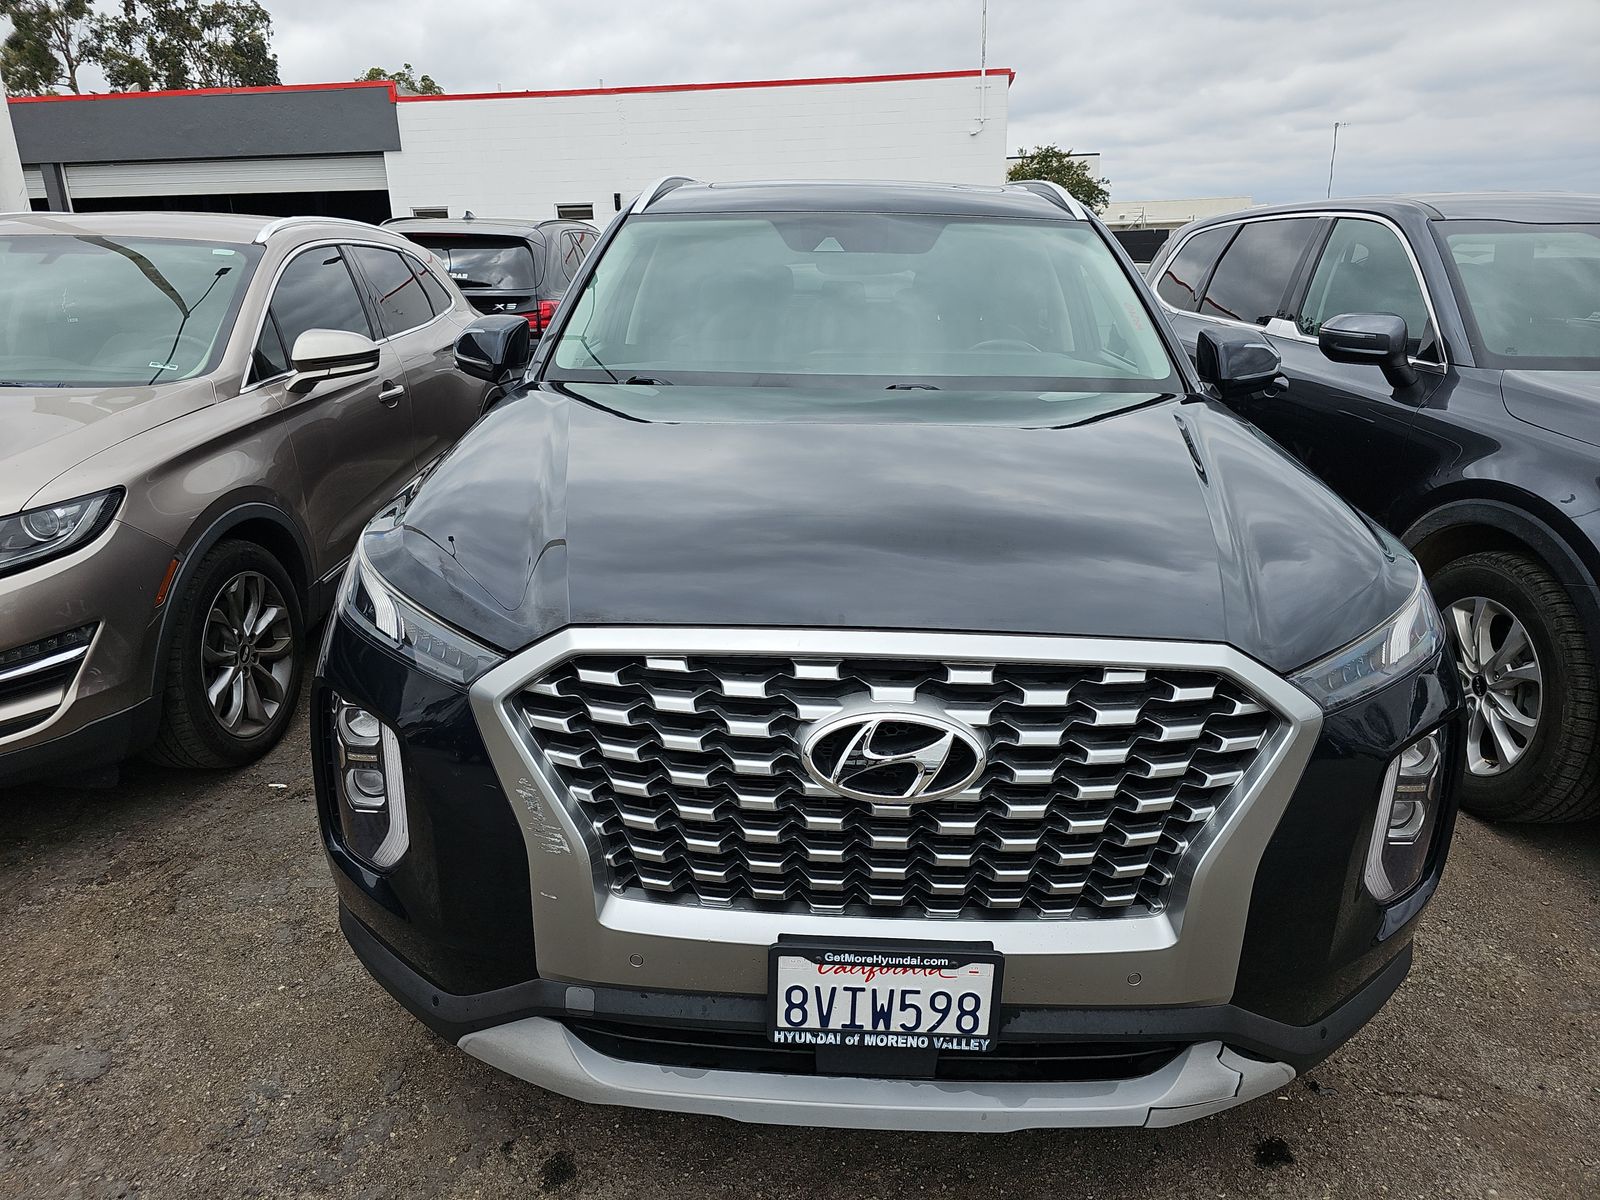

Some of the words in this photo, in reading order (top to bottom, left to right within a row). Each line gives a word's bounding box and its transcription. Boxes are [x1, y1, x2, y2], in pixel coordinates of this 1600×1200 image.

[824, 952, 949, 966] GetMoreHyundai.com
[784, 985, 981, 1034] 8VIW598
[774, 1030, 841, 1045] HYUNDAI
[845, 1033, 860, 1046] of
[864, 1034, 929, 1048] MORENO
[933, 1036, 990, 1051] VALLEY
